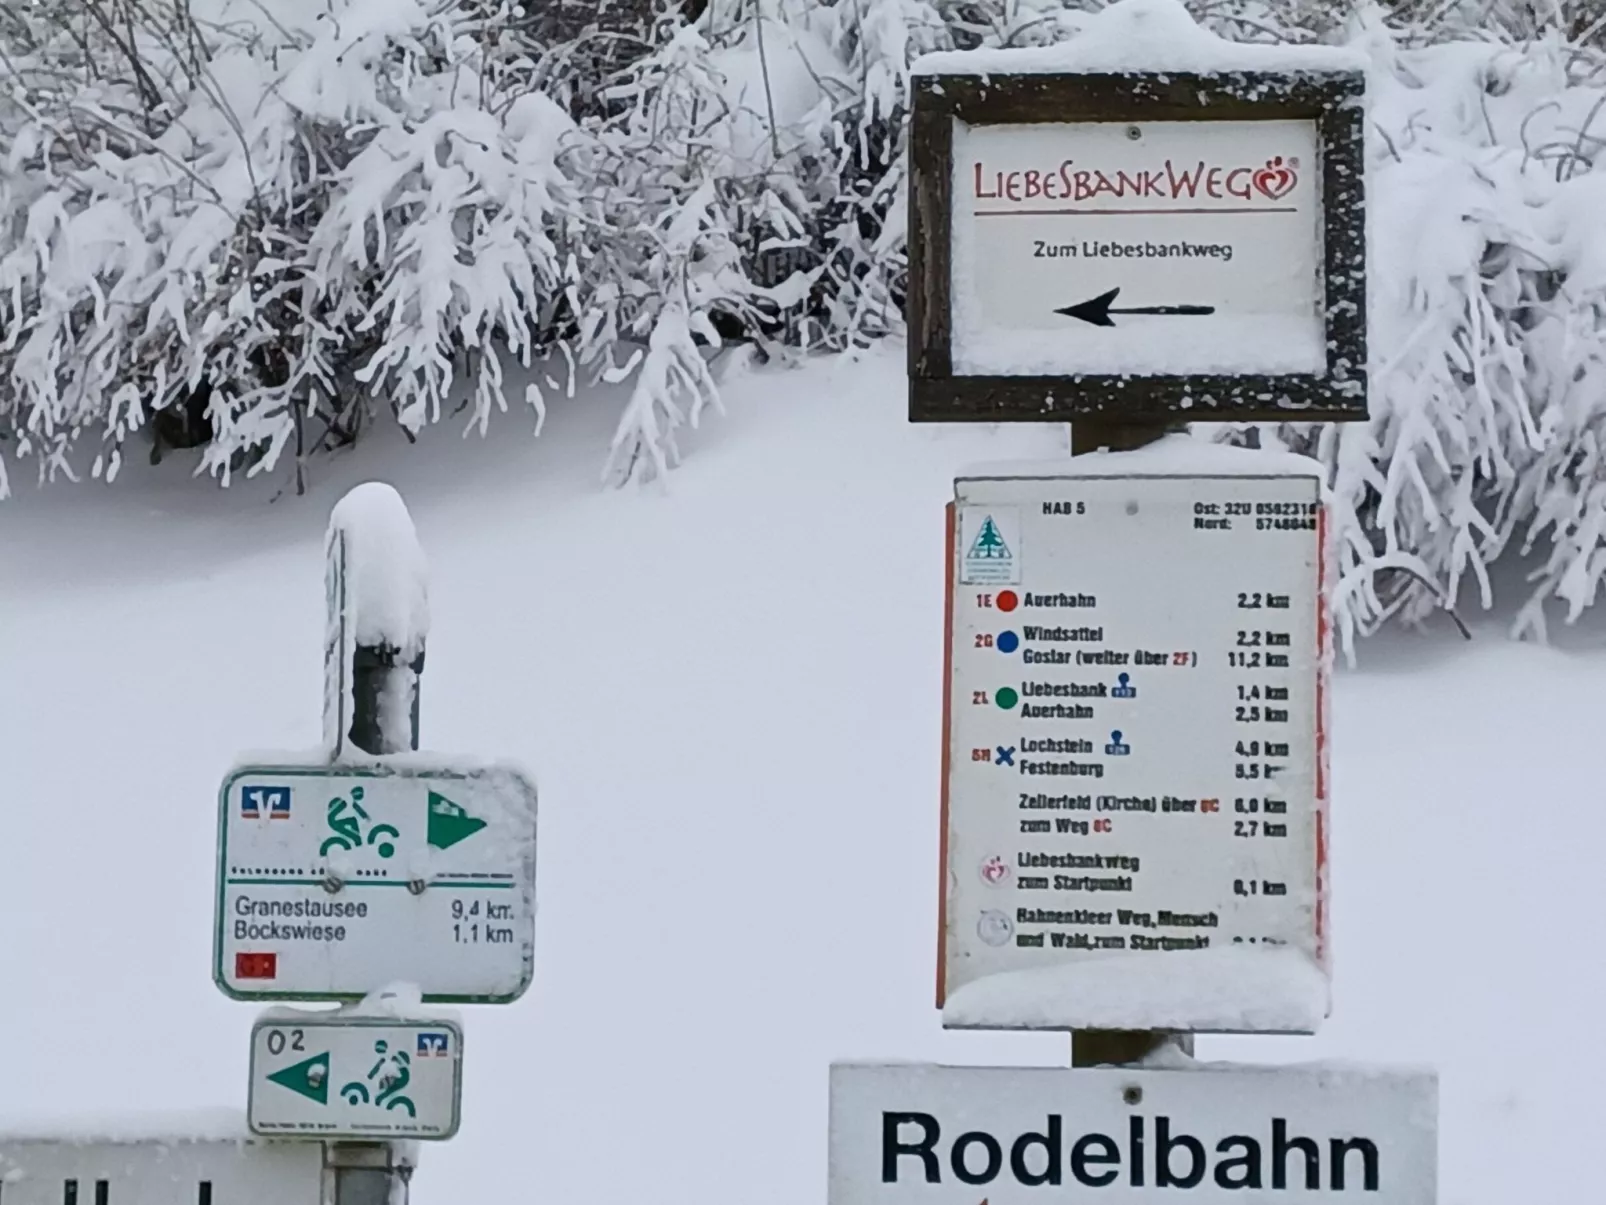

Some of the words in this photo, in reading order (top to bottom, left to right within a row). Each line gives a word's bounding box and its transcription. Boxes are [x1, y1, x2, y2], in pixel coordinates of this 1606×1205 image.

[1034, 241, 1077, 257] Zum
[1083, 241, 1232, 261] Liebesbankweg
[1043, 502, 1070, 515] HAB
[1076, 502, 1085, 514] 5
[977, 594, 992, 608] 1E
[1024, 592, 1096, 607] Auerhahn
[1238, 593, 1261, 608] 2,2
[1266, 593, 1289, 608] km
[1023, 626, 1103, 641] Windsattel
[1237, 631, 1261, 646] 2,2
[1266, 631, 1290, 646] km
[1023, 649, 1071, 664] Goslar
[1076, 650, 1129, 665] (weiter
[1134, 650, 1168, 665] über
[1228, 652, 1260, 668] 11,2
[1266, 652, 1289, 667] km
[1022, 682, 1107, 697] Liebesbank
[1238, 685, 1260, 701] 1,4
[1265, 686, 1288, 700] km
[1021, 703, 1093, 718] Auerhahn
[1236, 706, 1260, 722] 2,5
[1265, 707, 1288, 722] km
[1021, 737, 1092, 753] Lochstein
[1265, 742, 1289, 756] km
[1020, 759, 1103, 778] Festenburg
[1019, 794, 1091, 810] Zellerfeld
[1162, 796, 1196, 812] über
[1264, 798, 1286, 813] km
[1020, 820, 1050, 832] zum
[1055, 818, 1088, 835] Weg
[1234, 820, 1258, 837] 2,7
[1264, 821, 1286, 837] km
[1018, 852, 1139, 872] Liebesbankweg
[1017, 877, 1048, 889] zum
[1054, 875, 1132, 892] Startpunkt
[1234, 879, 1256, 896] 0,1
[1263, 881, 1286, 895] km
[236, 894, 367, 917] Granestausee
[452, 900, 479, 921] 9,4
[1017, 908, 1112, 924] Hahnenkleer
[235, 920, 345, 941] Bockswiese
[486, 924, 513, 943] km
[1017, 933, 1044, 947] und
[1130, 934, 1209, 951] Startpunkt
[882, 1111, 1378, 1191] Rodelbahn
